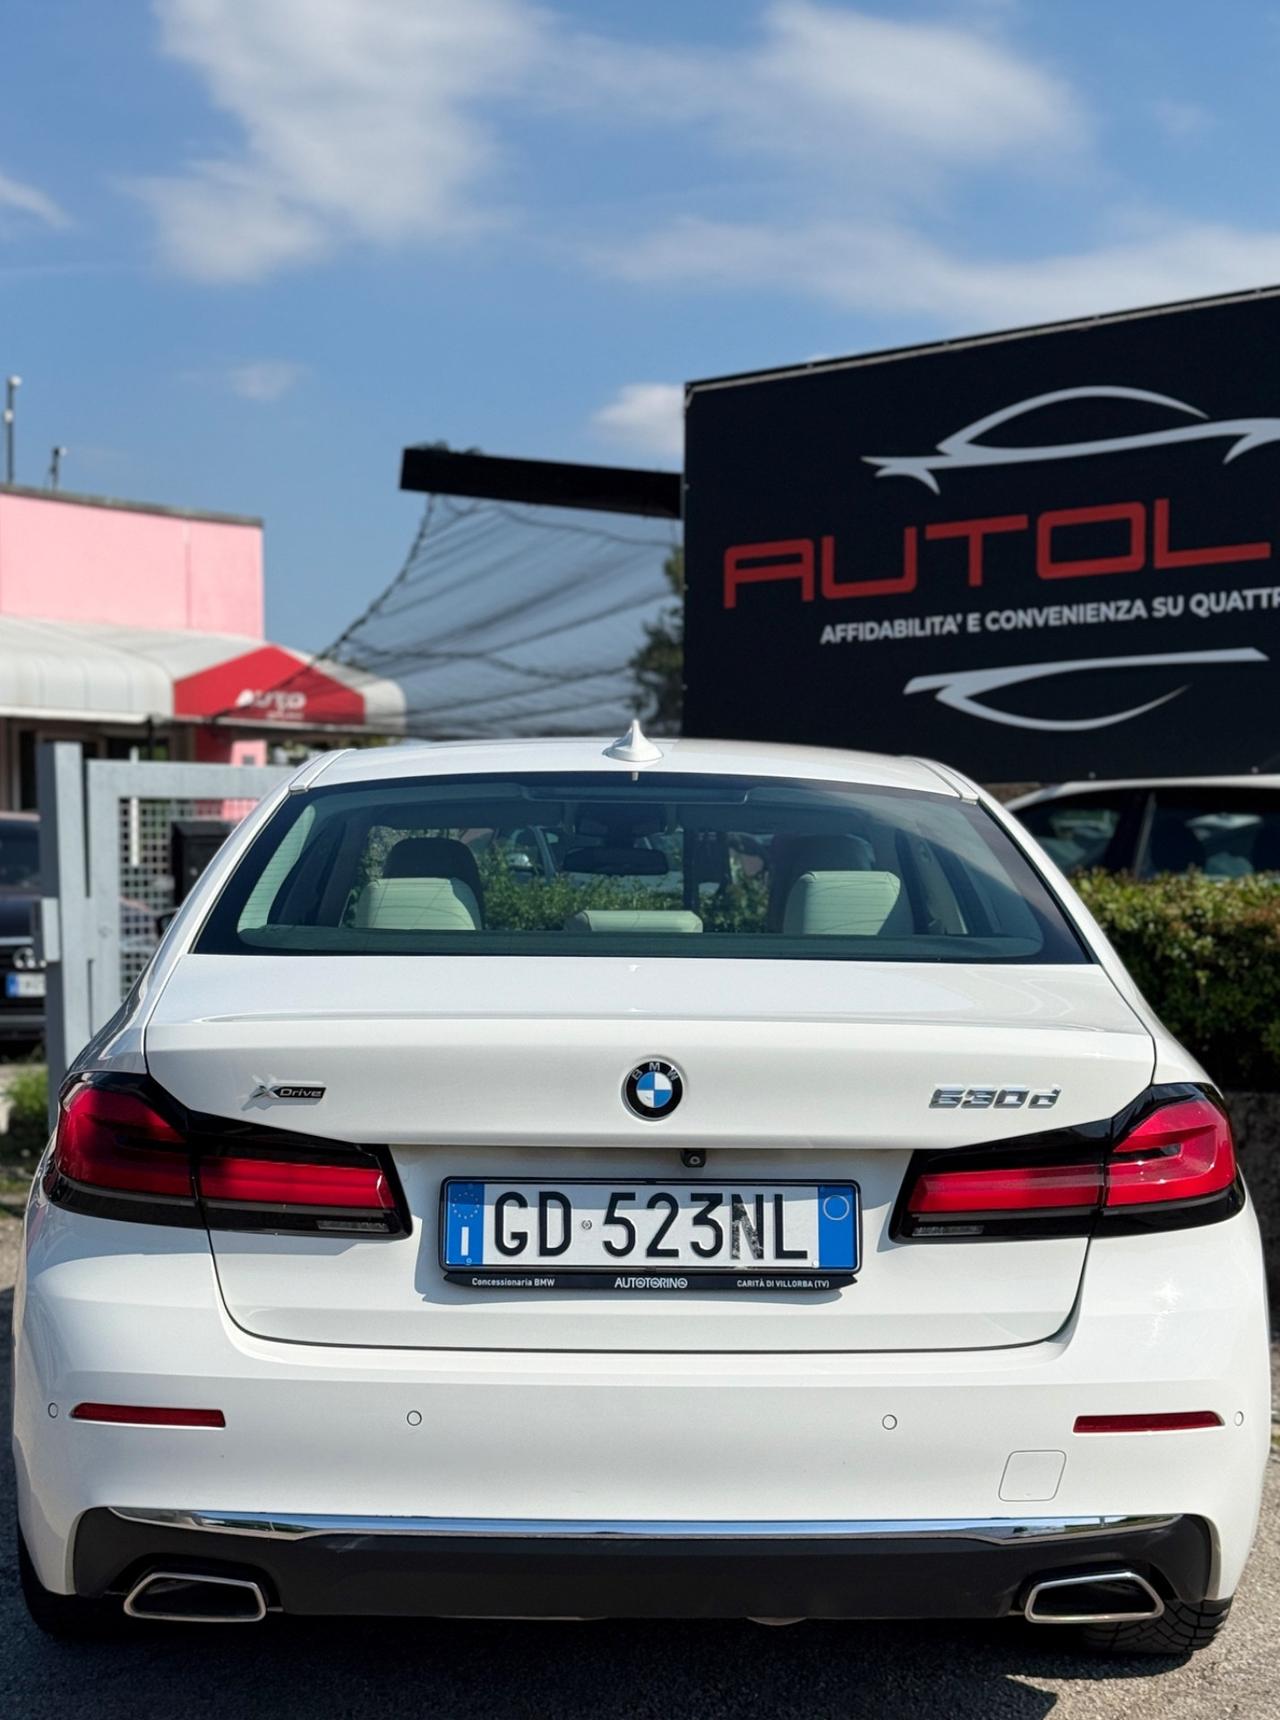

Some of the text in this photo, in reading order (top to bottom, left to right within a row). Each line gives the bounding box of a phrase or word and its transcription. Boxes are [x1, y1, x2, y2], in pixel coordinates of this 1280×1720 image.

[724, 498, 1271, 609] AUTOL
[820, 613, 962, 644] AFFIDABILITA'
[966, 612, 981, 633] E
[985, 598, 1148, 631] CONVENIENZA
[1151, 595, 1185, 618] SU
[631, 1062, 679, 1081] BMW
[494, 1191, 572, 1257] GD
[472, 1277, 555, 1287] Concessionaria BMW
[614, 1277, 688, 1289] AUTOTORINO
[737, 1278, 830, 1289] CARITÀ DI VILLORBA (TV)
